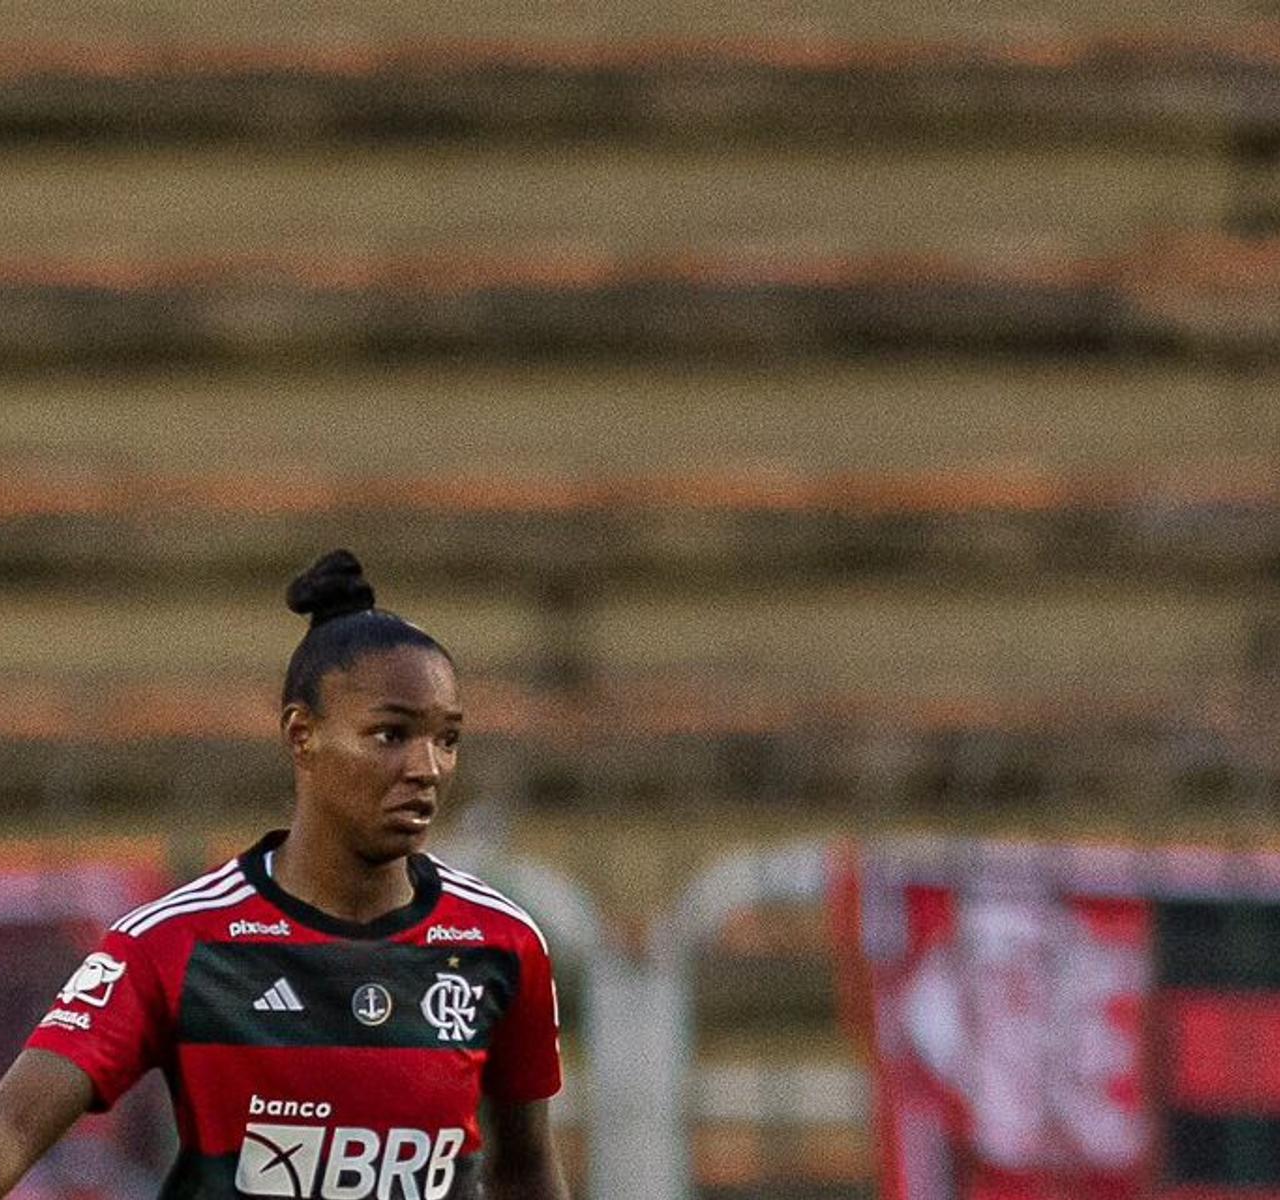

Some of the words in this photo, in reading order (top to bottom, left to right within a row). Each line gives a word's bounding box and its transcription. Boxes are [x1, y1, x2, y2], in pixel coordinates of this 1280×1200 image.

[228, 919, 291, 937] pixbet
[426, 923, 485, 944] pixbet
[248, 1094, 332, 1119] banco
